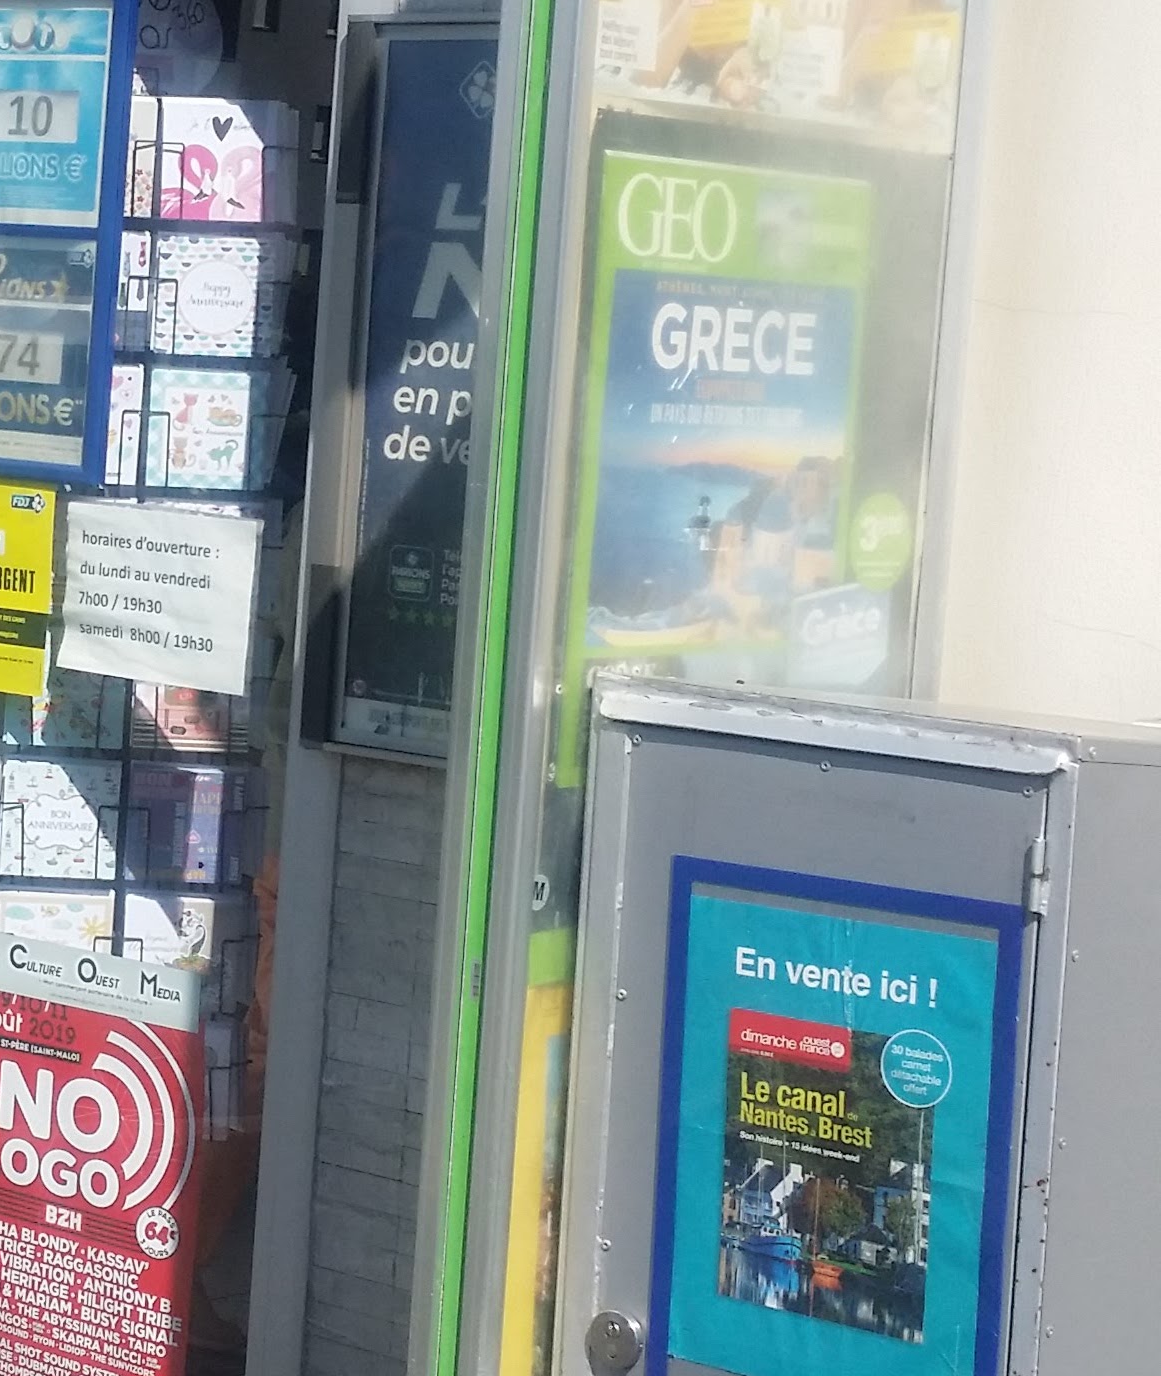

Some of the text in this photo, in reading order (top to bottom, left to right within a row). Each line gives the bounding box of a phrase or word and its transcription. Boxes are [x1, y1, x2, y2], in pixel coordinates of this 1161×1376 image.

[7, 94, 54, 137] 10
[617, 172, 737, 263] GEO
[652, 300, 818, 375] GRÈCE
[393, 386, 439, 415] en
[383, 424, 431, 462] de
[12, 496, 31, 508] FDJ
[82, 530, 211, 558] horaires d'ouverture
[80, 561, 211, 589] du lundi au vendredi
[78, 591, 163, 614] 7h00 19h30
[79, 623, 214, 652] samedi 8h00 19h30
[27, 820, 95, 833] ANNIVERSAIRE
[50, 809, 71, 819] BON
[735, 946, 938, 1008] En vente ici !
[29, 1017, 77, 1044] 2019
[740, 1028, 797, 1050] dimanche
[802, 1035, 831, 1047] ouest
[799, 1041, 831, 1056] france
[891, 1044, 944, 1062] 30 balades
[891, 1069, 942, 1087] détachable
[901, 1059, 931, 1073] carnet
[740, 1071, 845, 1119] Le canal
[903, 1083, 927, 1096] offert
[739, 1100, 872, 1149] Nantes Brest
[739, 1130, 754, 1141] Son
[755, 1133, 784, 1147] histoire
[791, 1141, 800, 1151] 15
[823, 1149, 860, 1163] week-end
[45, 1204, 82, 1231] BZH
[146, 1209, 156, 1218] LE
[21, 1227, 79, 1255] BLONDY
[0, 1250, 75, 1286] VIBRATION
[83, 1276, 158, 1309] ANTHONY
[159, 1297, 172, 1314] B
[43, 1249, 139, 1289] RAGGASONIC
[0, 1267, 70, 1300] HERITAGE
[77, 1290, 134, 1318] HILIGHT
[136, 1307, 182, 1332] TRIBE
[14, 1286, 73, 1316] MARIAM
[81, 1305, 119, 1330] BUSY
[121, 1319, 178, 1346] SIGNAL
[16, 1302, 40, 1320] THE
[42, 1311, 121, 1345] ABYSSINIANS
[128, 1337, 167, 1358] TAIRO
[14, 1342, 42, 1360] SHOT
[43, 1351, 81, 1372] SOUND
[52, 1327, 101, 1352] SKARRA
[103, 1344, 142, 1365] MUCCI
[90, 1351, 107, 1364] THE
